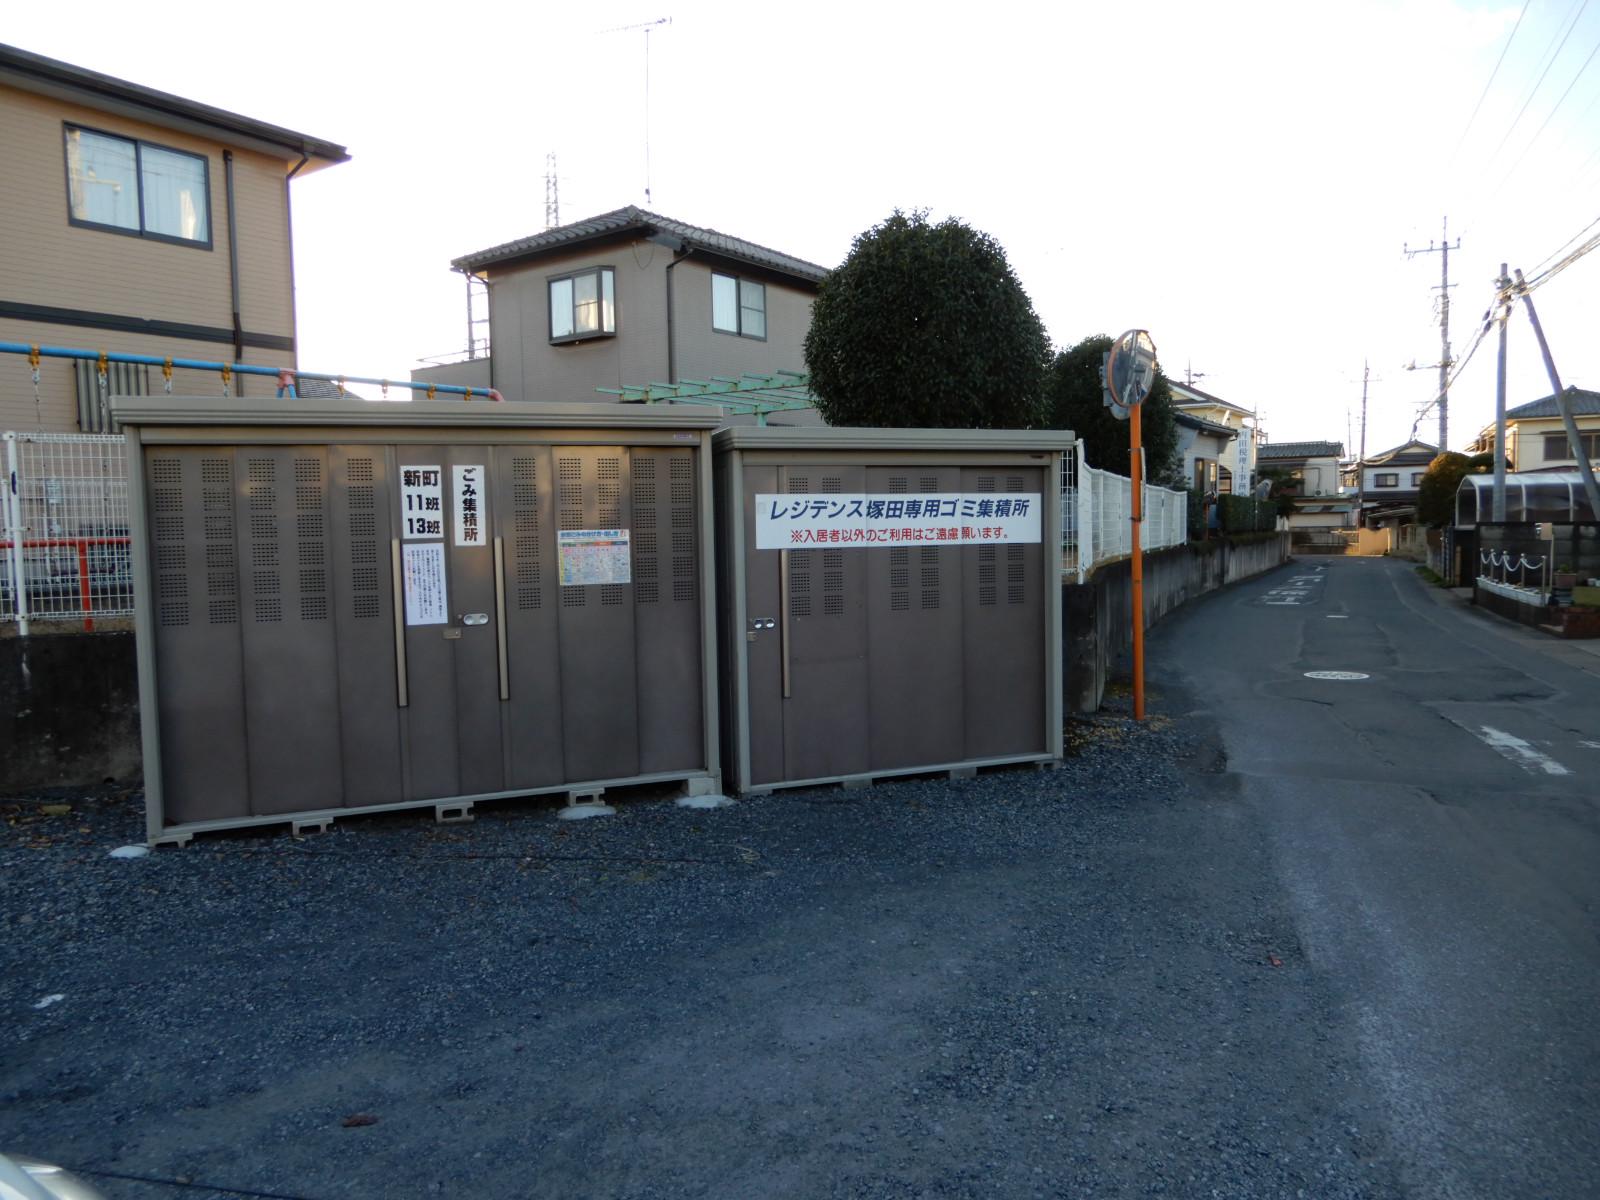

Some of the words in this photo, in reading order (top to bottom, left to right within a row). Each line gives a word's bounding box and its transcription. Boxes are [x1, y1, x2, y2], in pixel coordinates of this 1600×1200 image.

[403, 469, 440, 488] 新町
[406, 494, 440, 511] 11班
[462, 467, 478, 542] ごみ集積所
[770, 498, 1030, 520] レジデンス塚田専用ゴミ集積所
[407, 517, 441, 535] 13班
